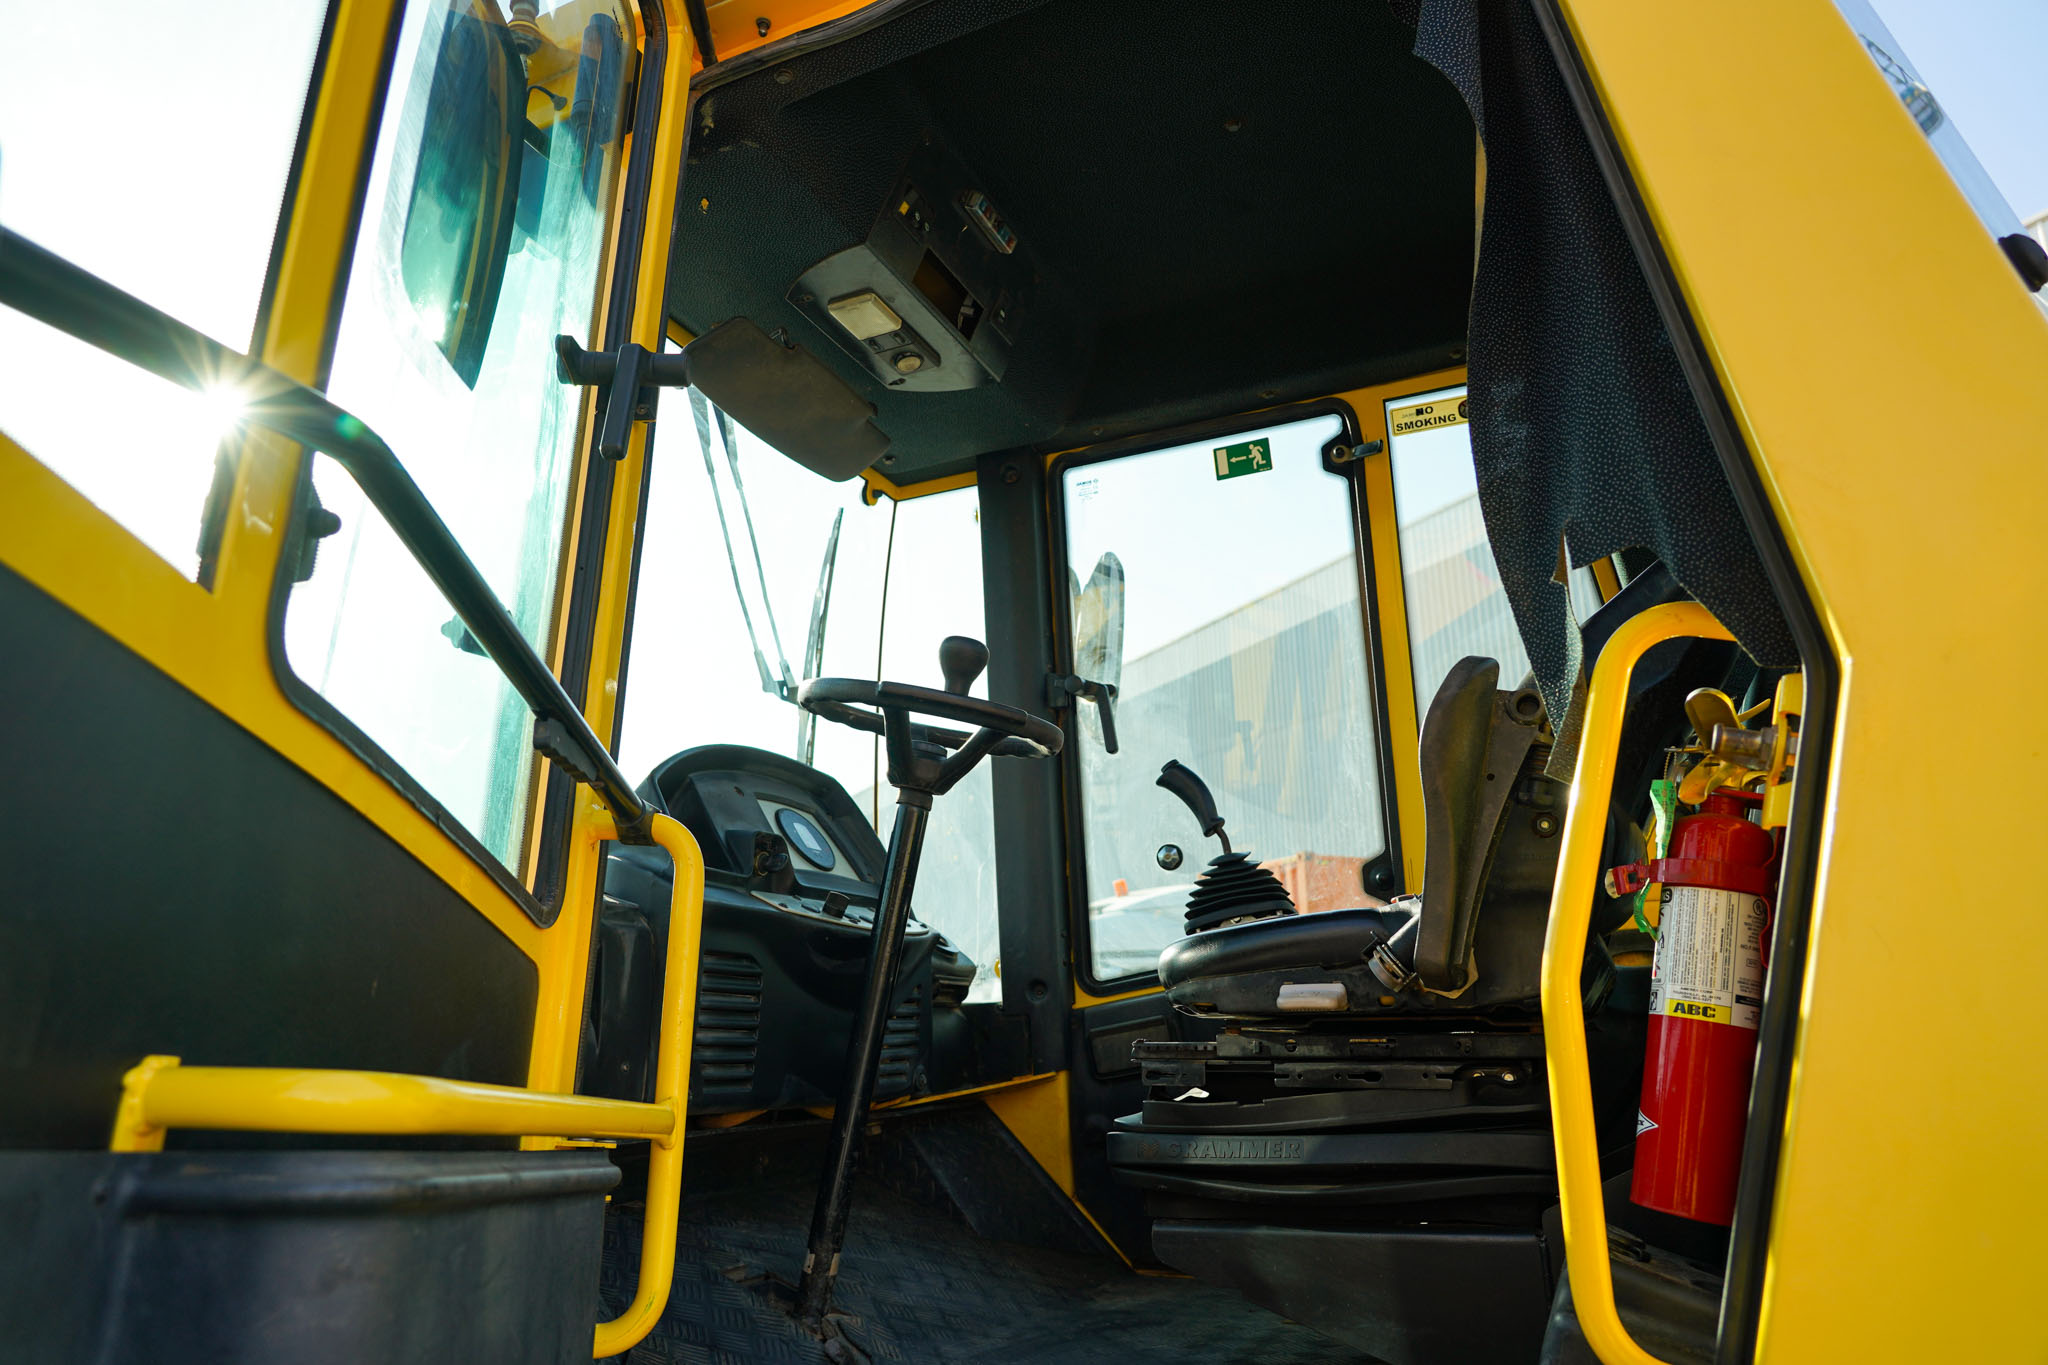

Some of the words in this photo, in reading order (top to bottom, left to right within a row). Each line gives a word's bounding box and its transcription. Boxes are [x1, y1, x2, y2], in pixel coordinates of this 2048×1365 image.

[1396, 413, 1457, 432] SMOKING
[1673, 1002, 1716, 1018] ABC
[1167, 1138, 1301, 1160] GRAMMER
